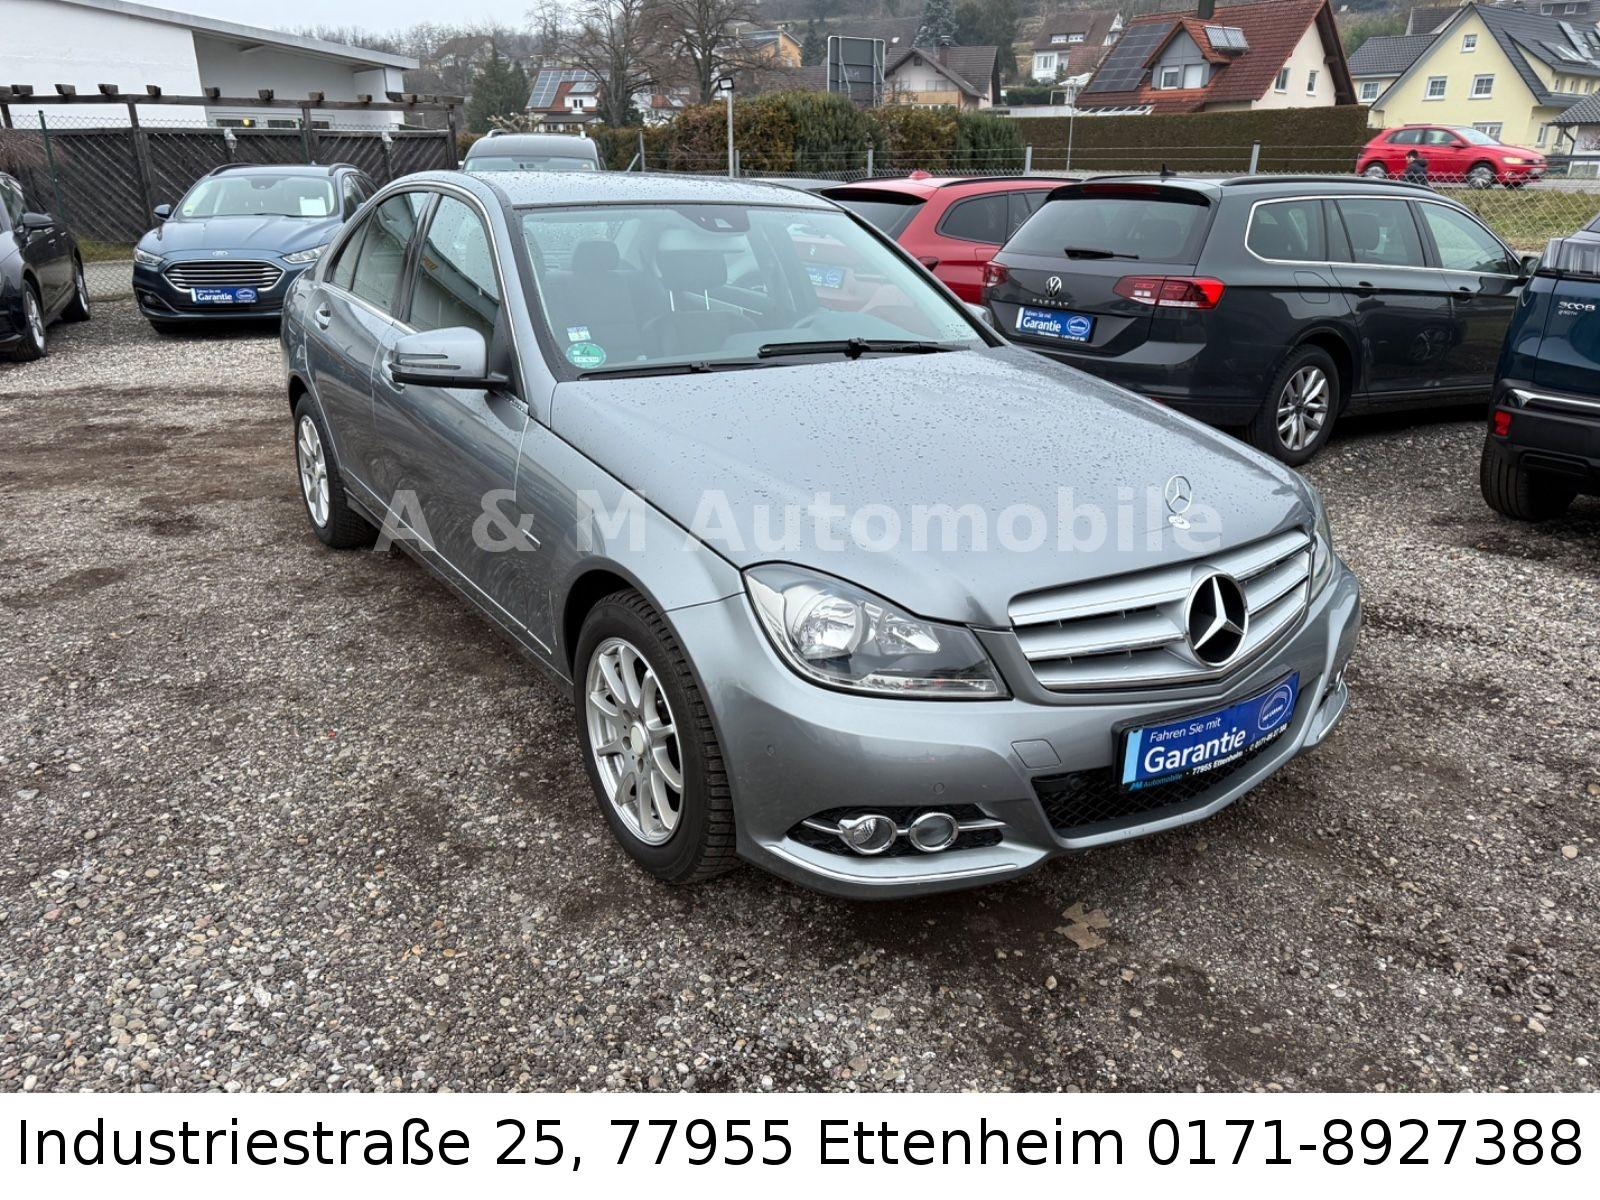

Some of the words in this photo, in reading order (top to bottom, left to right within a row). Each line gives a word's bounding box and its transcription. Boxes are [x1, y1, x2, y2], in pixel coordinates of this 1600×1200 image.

[1023, 316, 1061, 332] Garantie
[1149, 729, 1187, 744] Fahren
[1188, 722, 1205, 736] Sie
[1205, 716, 1222, 731] mit
[1144, 726, 1246, 773] Garantie
